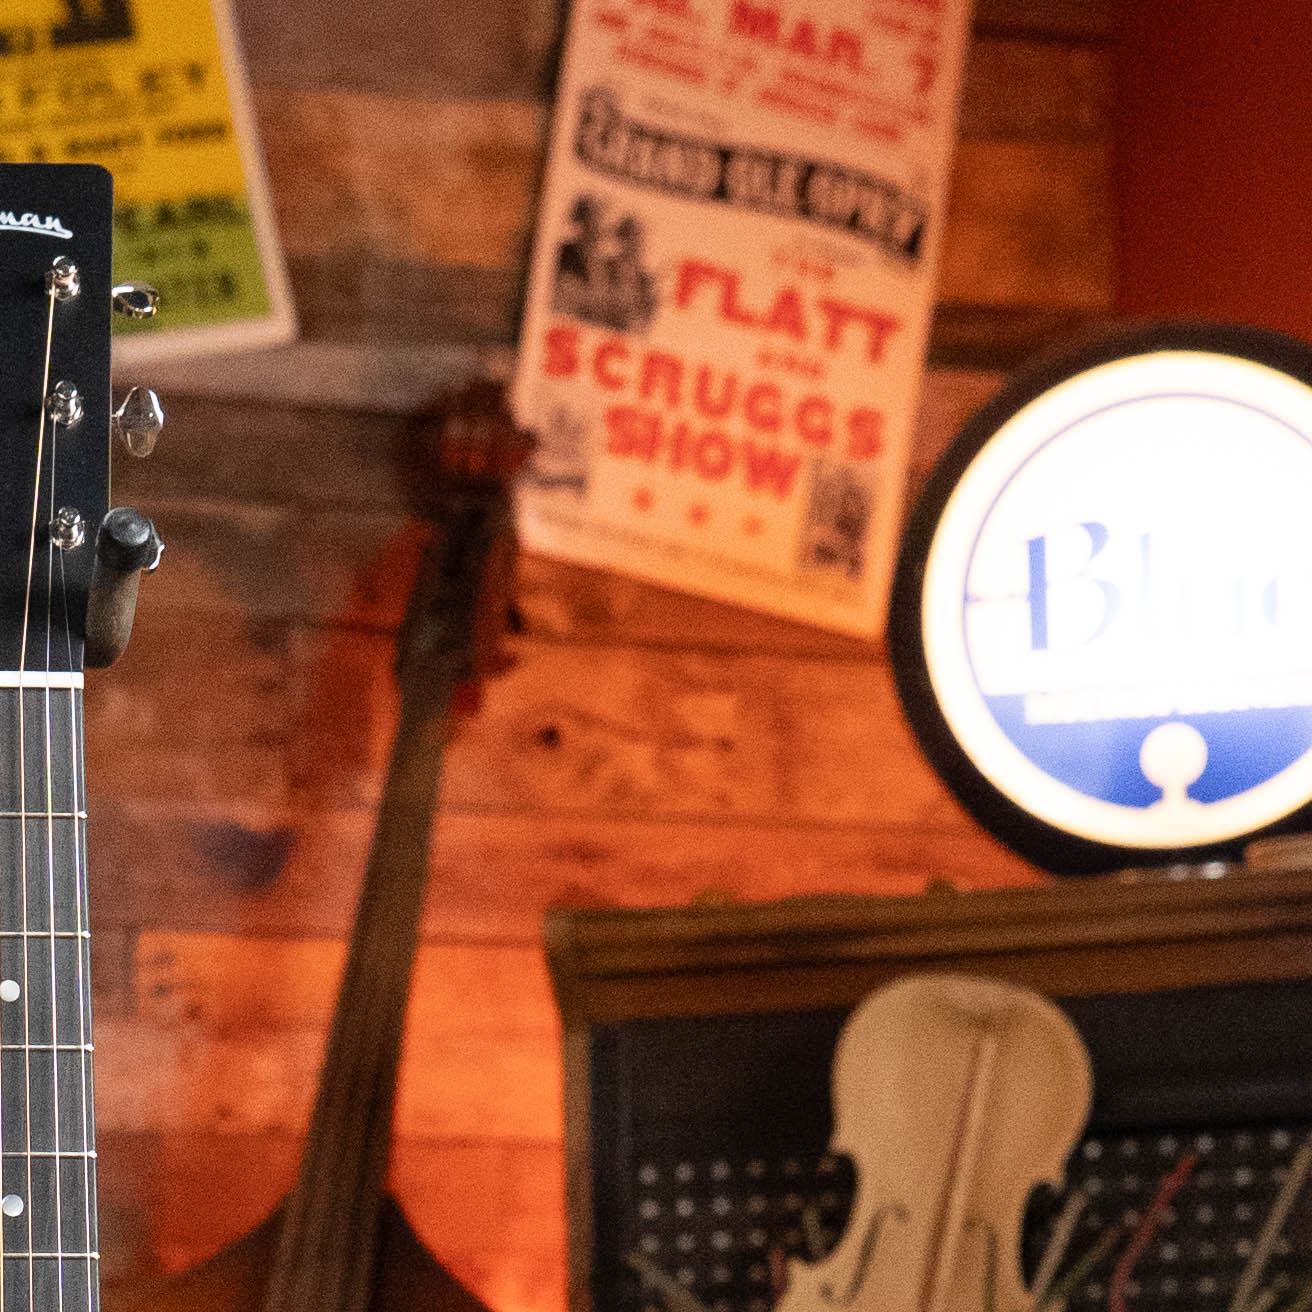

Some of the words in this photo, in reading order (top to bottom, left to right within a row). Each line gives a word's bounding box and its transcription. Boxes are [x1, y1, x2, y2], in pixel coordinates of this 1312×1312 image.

[675, 259, 904, 366] FLATT
[542, 326, 885, 461] SCRUGGS
[604, 404, 801, 501] SHOW
